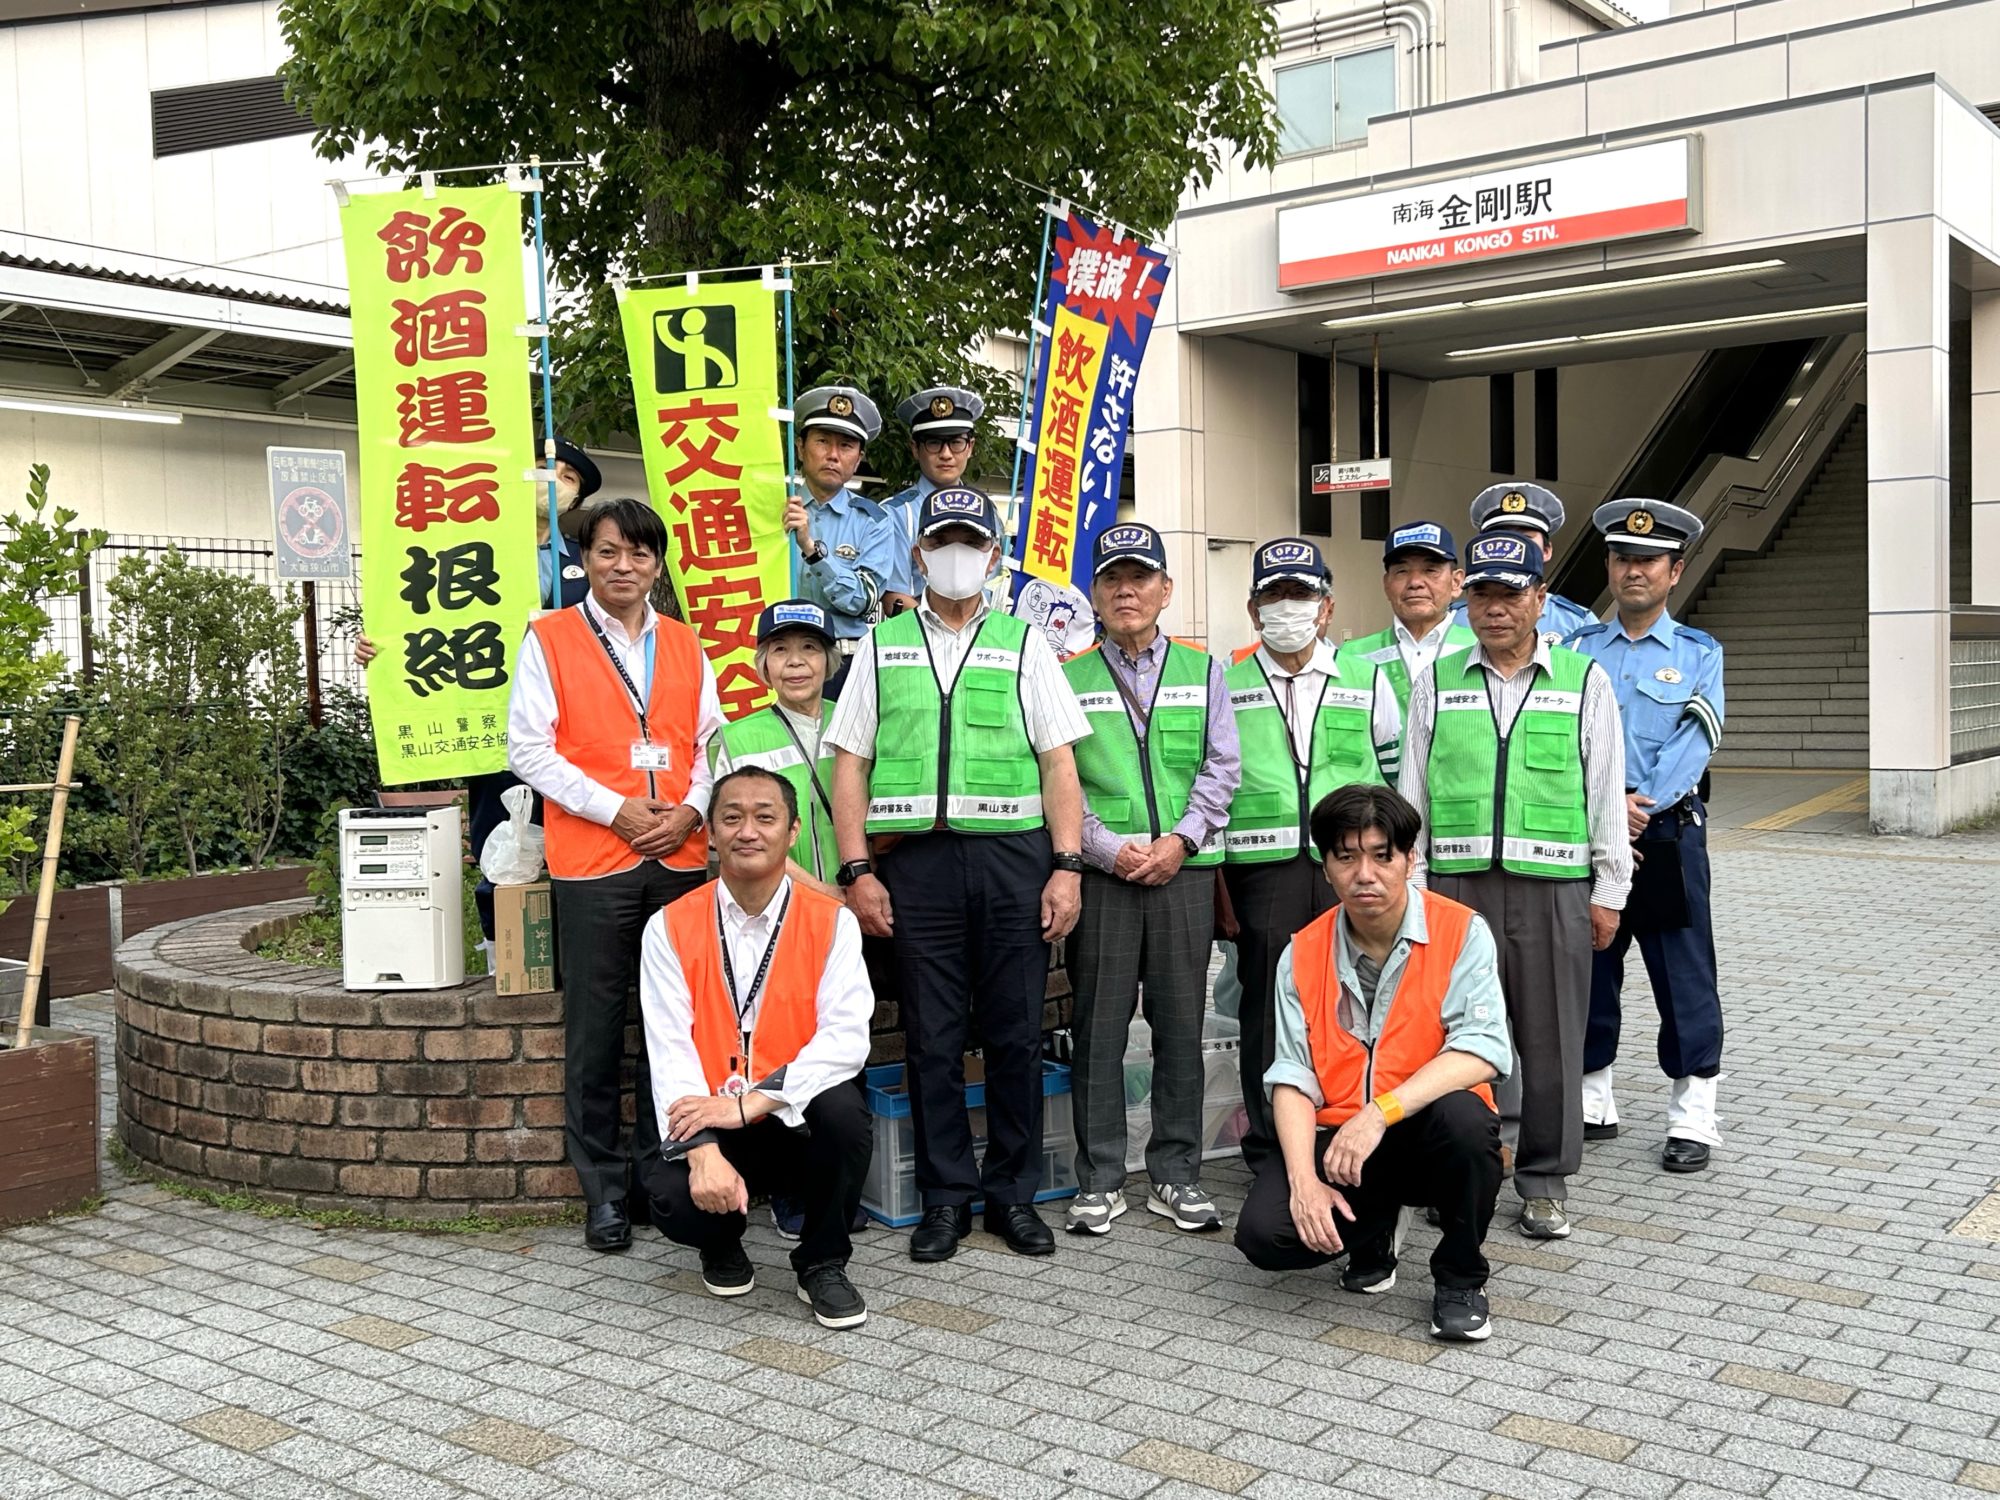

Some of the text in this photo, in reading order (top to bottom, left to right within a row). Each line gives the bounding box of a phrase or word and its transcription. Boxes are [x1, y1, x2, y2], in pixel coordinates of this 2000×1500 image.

[1387, 225, 1559, 266] NANKAI KONGŌ STN.
[377, 207, 509, 698] 飲酒運転根絶
[1032, 326, 1096, 573] 飲酒運転
[945, 493, 970, 504] OPS
[1114, 530, 1137, 540] OPS
[1276, 546, 1299, 556] OPS
[1486, 542, 1511, 552] OPS
[657, 397, 773, 723] 交通安全
[884, 652, 919, 661] 地域安全
[976, 653, 1012, 663] サポーター
[1080, 696, 1114, 706] 地域安全
[1164, 692, 1199, 701] サポーター
[1231, 693, 1264, 705] 地域安全
[1332, 692, 1366, 702] サポーター
[1444, 694, 1478, 705] 地域安全
[1534, 696, 1572, 706] サポーター
[869, 803, 913, 814] 阪府警友会
[1226, 834, 1277, 846] 大阪府警友会
